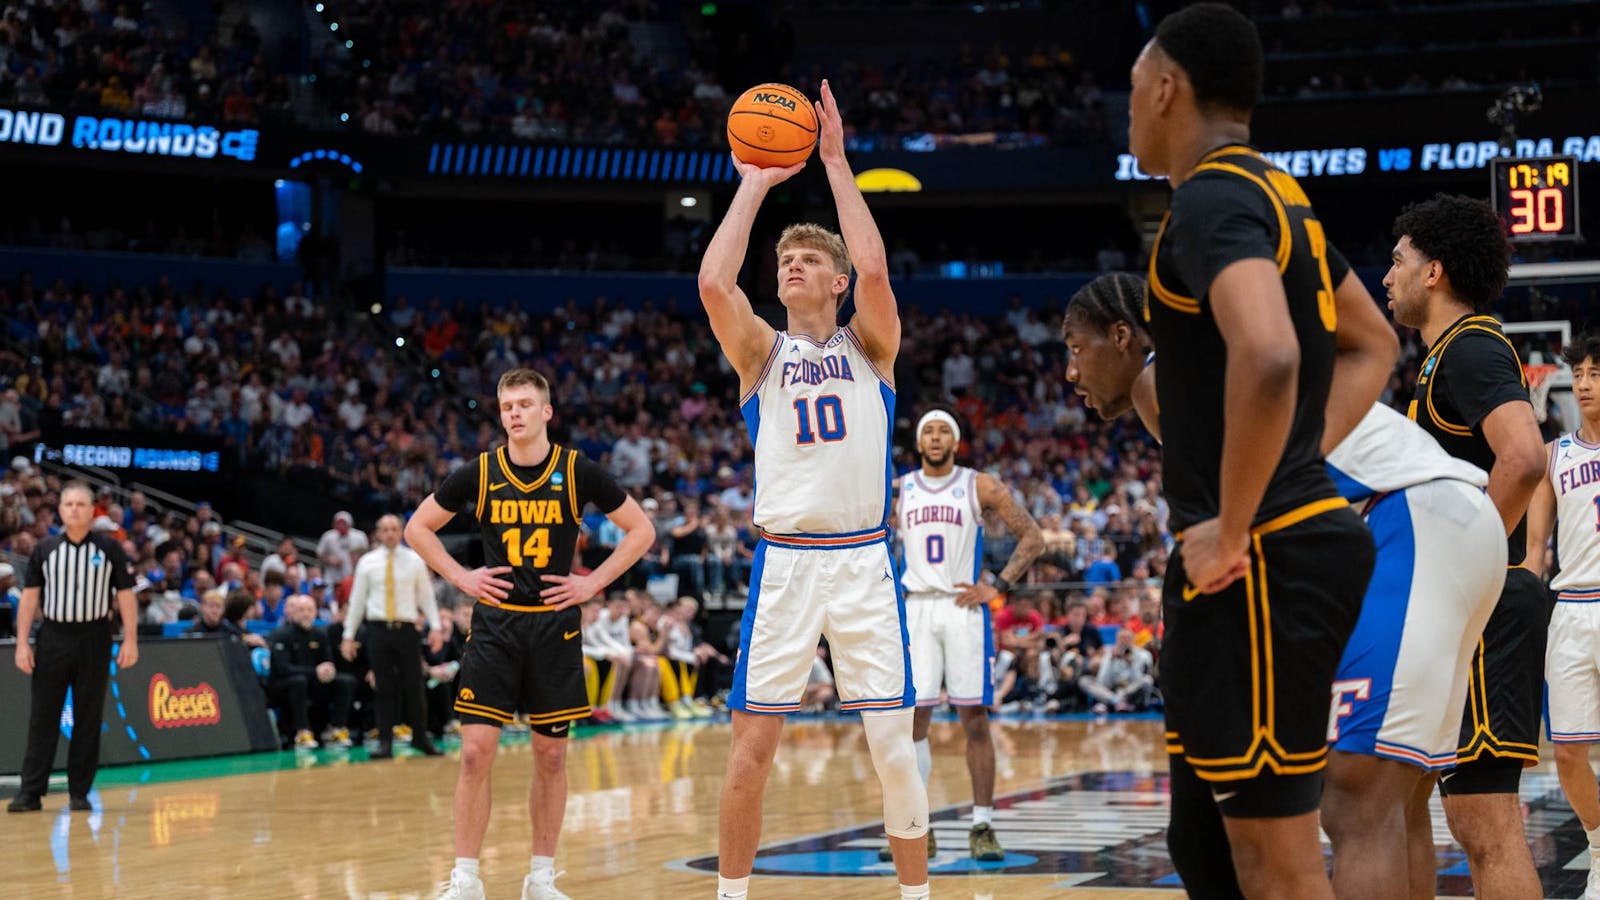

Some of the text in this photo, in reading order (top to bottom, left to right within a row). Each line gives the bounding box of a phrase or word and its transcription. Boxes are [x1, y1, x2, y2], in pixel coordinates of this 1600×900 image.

[753, 93, 796, 112] NCAA
[73, 116, 219, 158] ROUNDS
[1378, 148, 1412, 171] VS
[1509, 162, 1569, 189] 17:19
[1510, 188, 1563, 233] 30
[781, 354, 855, 388] FLORIDA
[793, 394, 847, 445] 10
[63, 444, 132, 468] SECOND
[490, 499, 563, 524] IOWA
[906, 505, 963, 530] FLORIDA
[502, 527, 552, 568] 14
[926, 534, 945, 565] 0
[153, 680, 217, 722] Reese's
[1326, 677, 1372, 742] F
